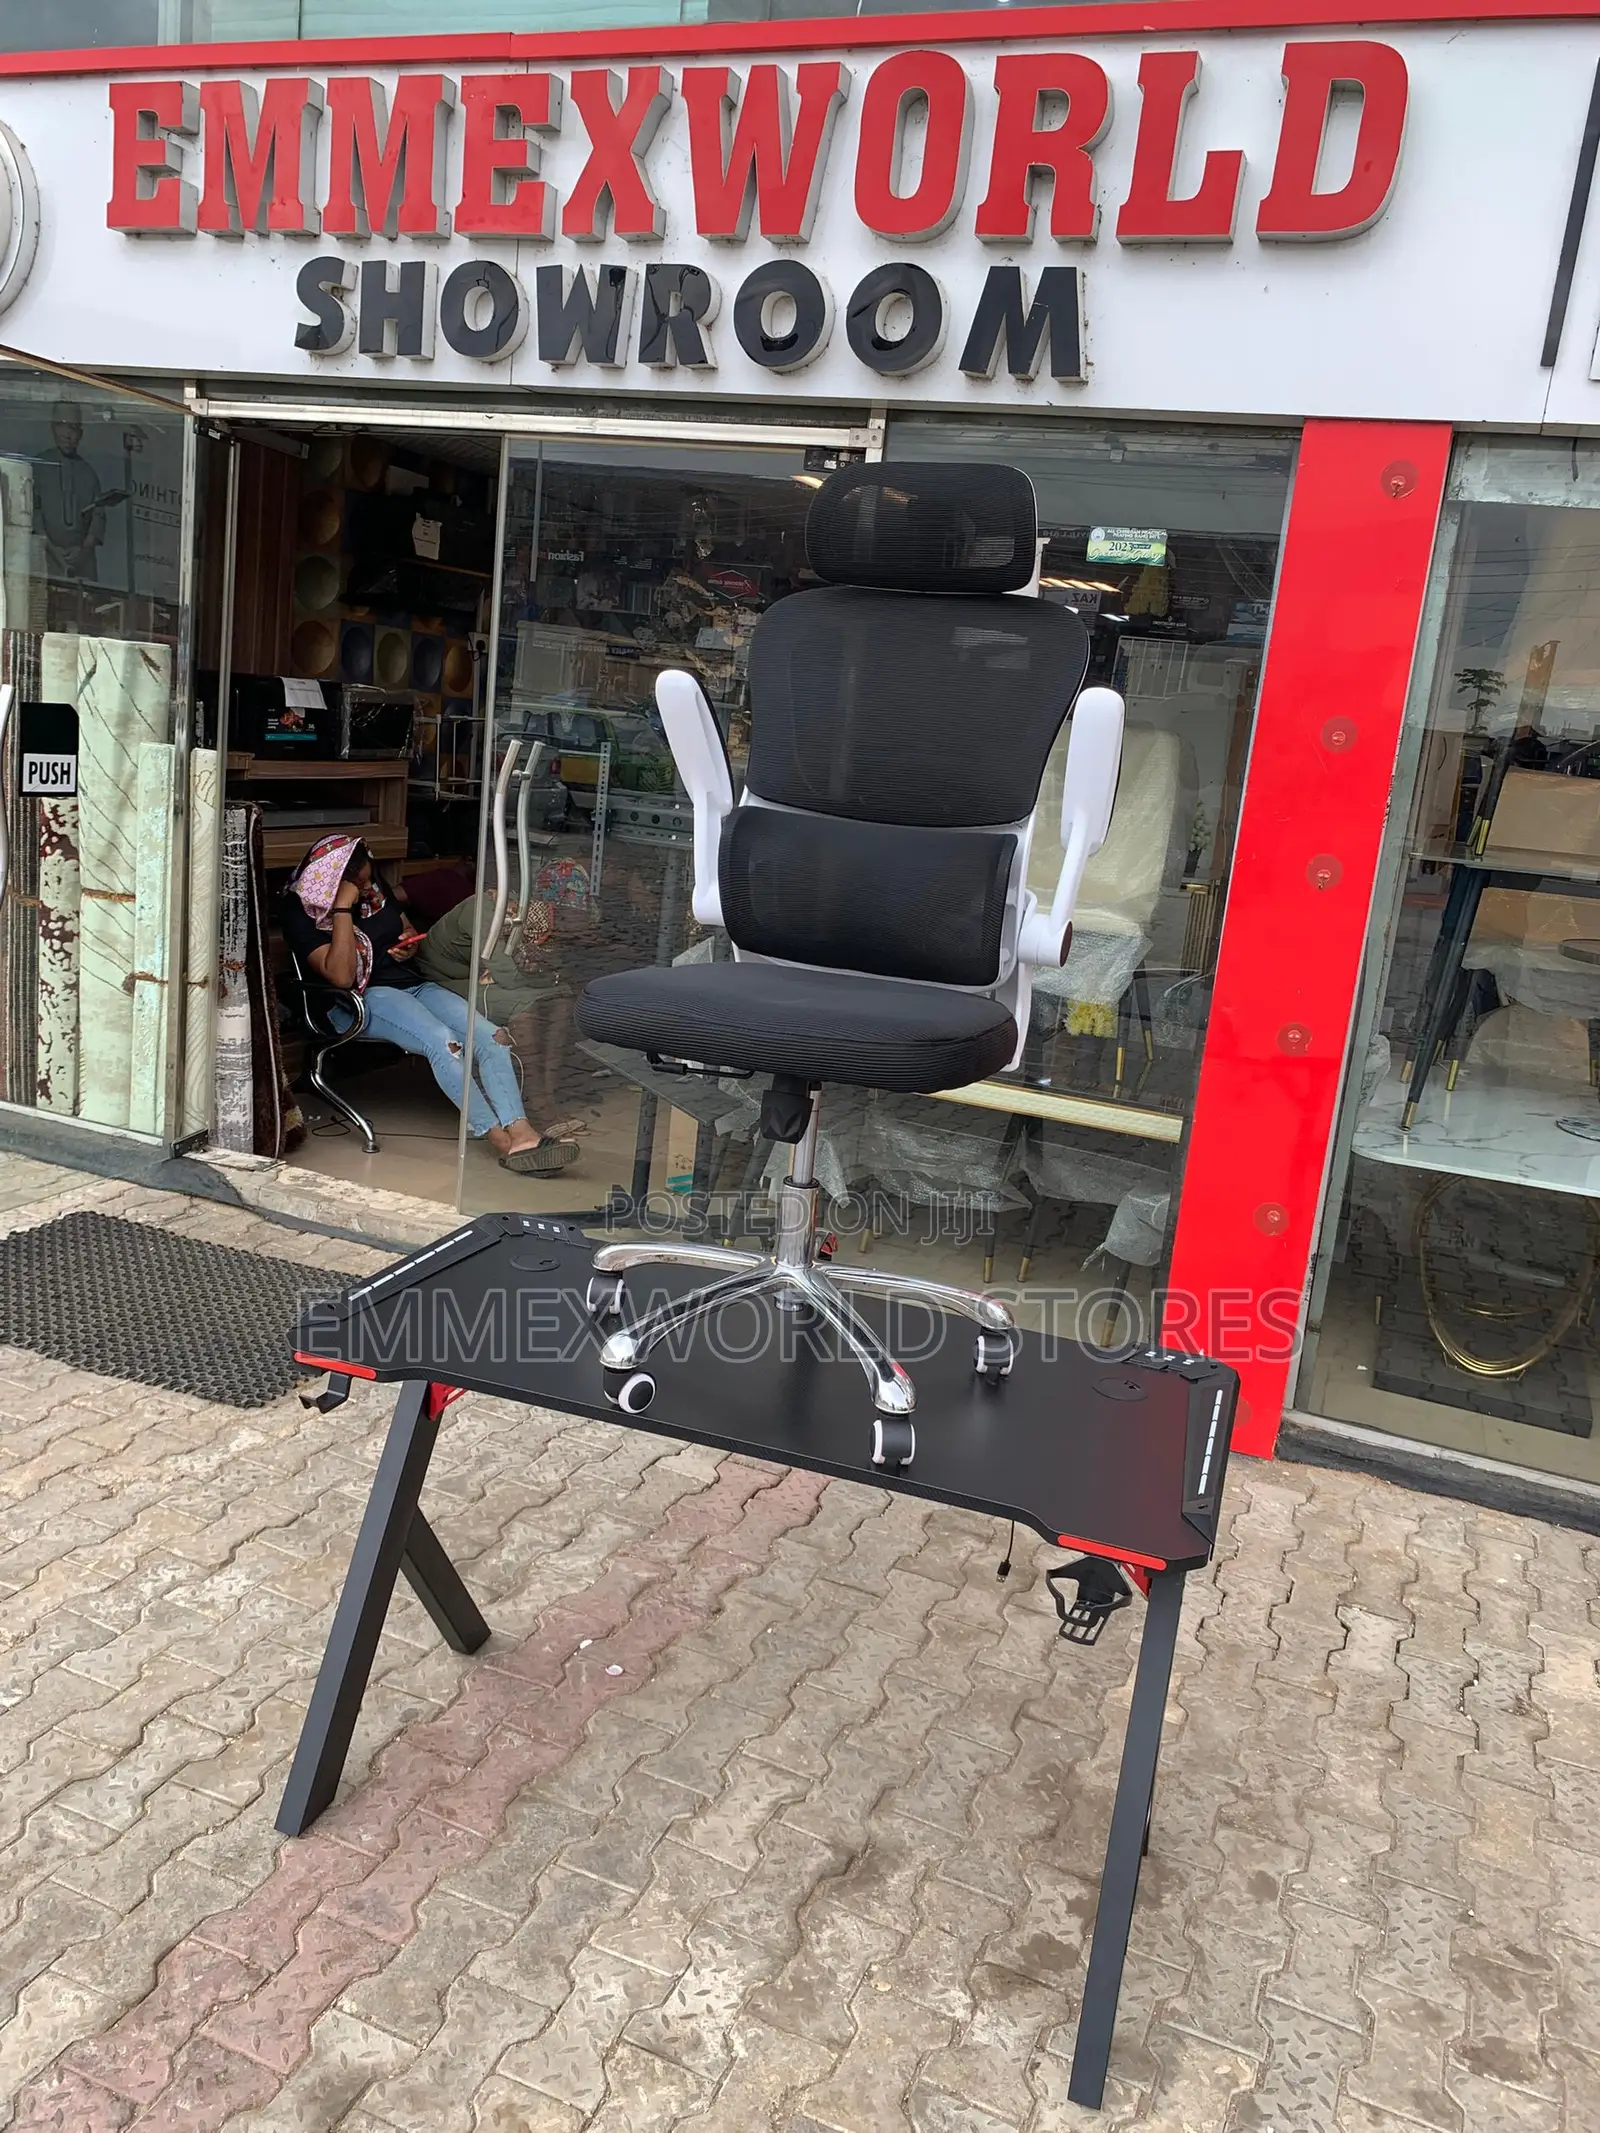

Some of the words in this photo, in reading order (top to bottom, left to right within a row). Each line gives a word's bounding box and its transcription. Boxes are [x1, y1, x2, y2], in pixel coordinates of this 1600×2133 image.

[106, 40, 1411, 244] EMMEXWORLD
[294, 255, 1089, 383] SHOWROOM
[1109, 541, 1134, 552] 2023
[28, 761, 71, 785] PUSH
